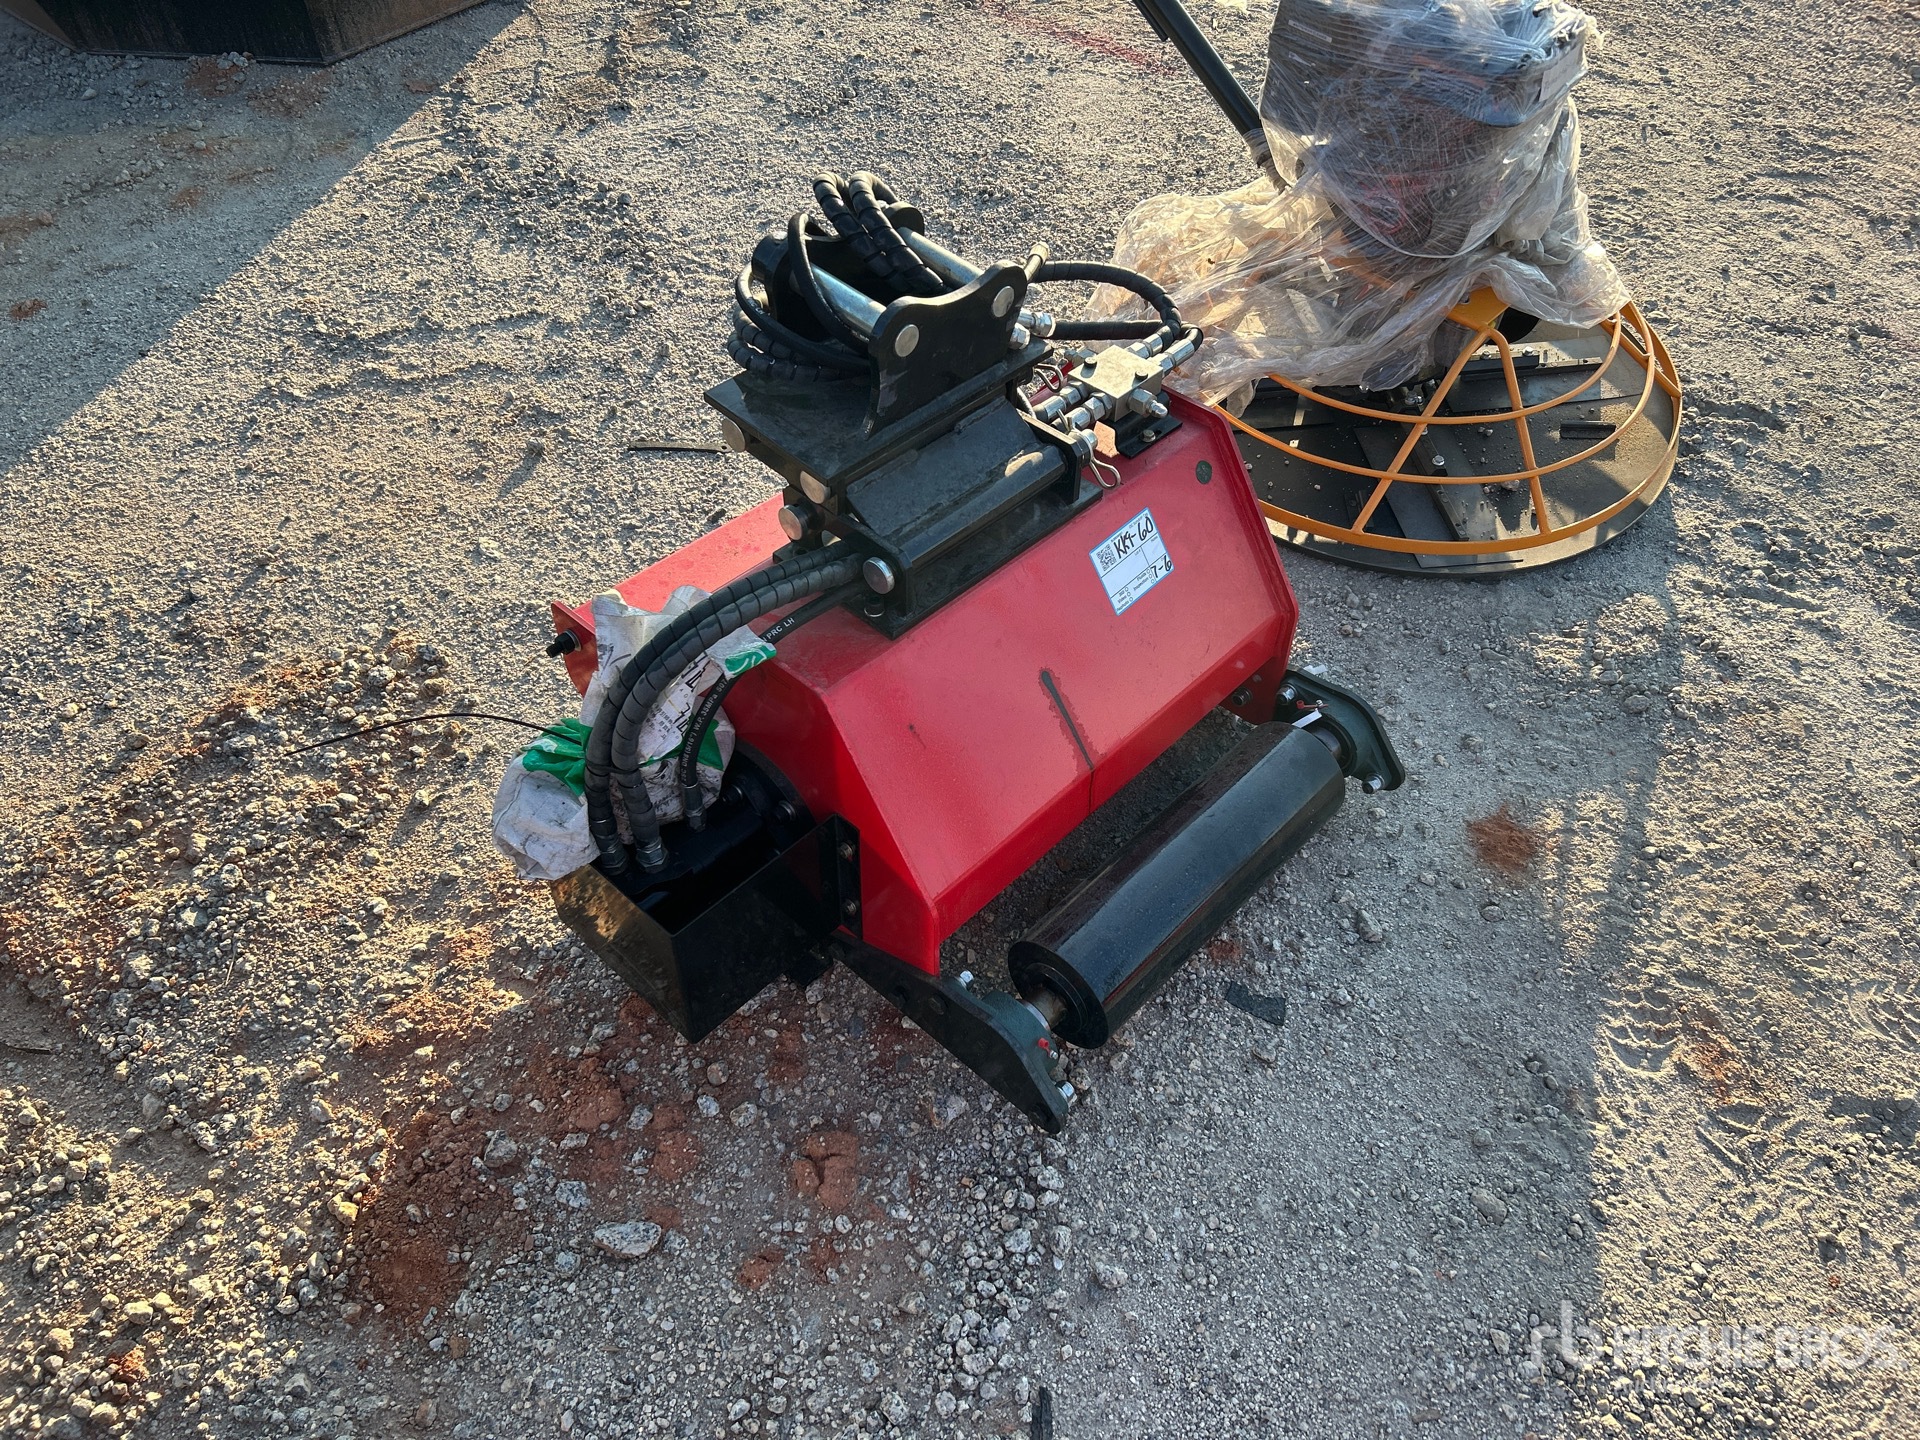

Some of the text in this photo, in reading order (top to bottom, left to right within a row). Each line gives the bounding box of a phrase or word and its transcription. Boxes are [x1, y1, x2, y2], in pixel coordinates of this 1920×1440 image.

[766, 625, 783, 639] PRC
[783, 617, 795, 627] LH
[700, 694, 718, 716] 35MPa
